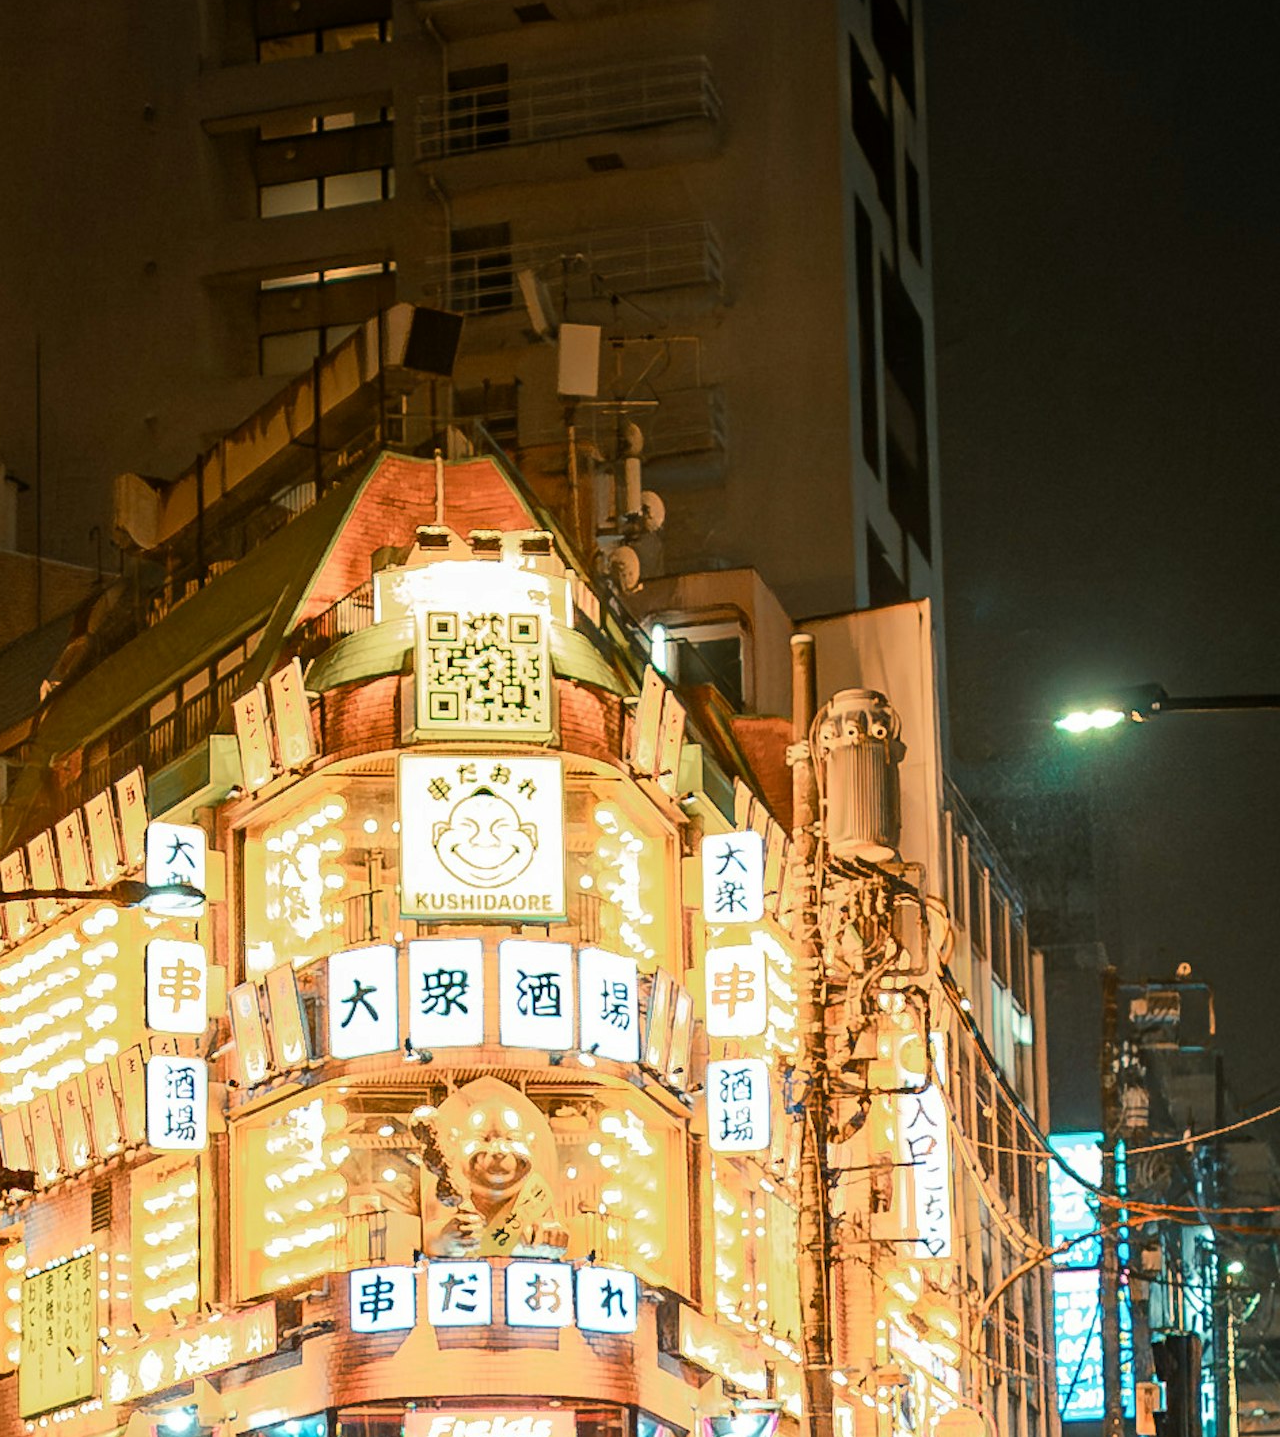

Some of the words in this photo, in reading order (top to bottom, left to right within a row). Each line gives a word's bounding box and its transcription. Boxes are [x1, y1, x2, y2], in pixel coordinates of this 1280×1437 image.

[426, 762, 538, 802] 串だおれ
[415, 892, 553, 911] KUSHIDAORE
[359, 1272, 628, 1323] 串だおれ
